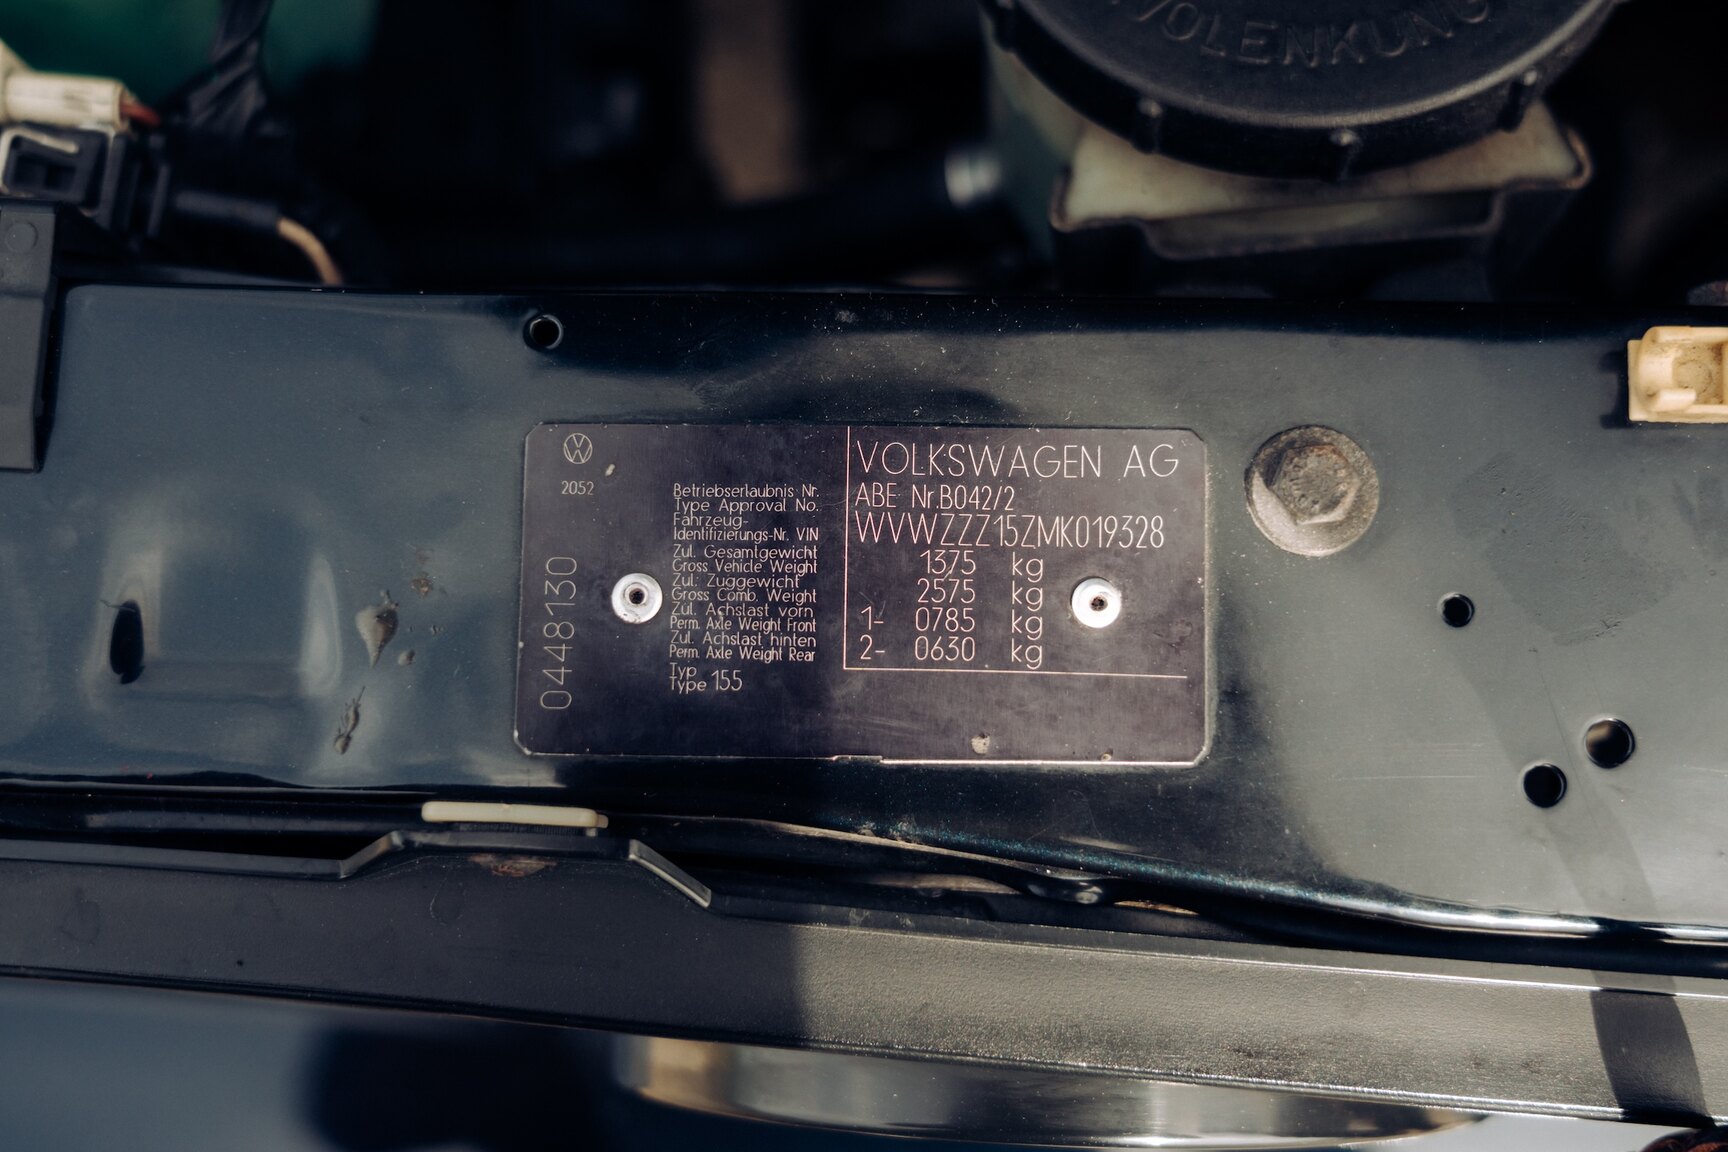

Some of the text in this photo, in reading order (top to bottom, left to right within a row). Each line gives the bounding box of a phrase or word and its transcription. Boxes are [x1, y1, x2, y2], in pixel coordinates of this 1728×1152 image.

[857, 440, 1178, 478] VOLKSWAGEN AG
[561, 480, 594, 496] 2052
[674, 483, 819, 498] Betriebserlaubnis Nr.
[855, 482, 897, 508] ABE
[675, 498, 819, 515] Type Approval No.
[674, 512, 748, 530] Fahrzeug-
[855, 511, 1164, 549] WVWZZZ15ZMK019328
[674, 527, 819, 544] Identifizierungs-Nr. VIN
[673, 544, 817, 562] Zul. Gesamtgewicht
[672, 559, 817, 577] Gross Vehicle Weight
[920, 550, 1043, 582] 1375 kg
[672, 573, 799, 590] Zul. Zuggewicht
[672, 588, 816, 606] Gross Comb. Weight
[917, 578, 1043, 611] 2575 kg
[672, 602, 813, 618] Zul. Achslast vorn
[670, 616, 816, 633] Perm. Axle Weight Front
[916, 607, 975, 632] 0785
[1011, 610, 1043, 640] kg
[540, 557, 577, 709] 0448130
[670, 630, 816, 647] Zul. Achslast hinten
[669, 645, 815, 663] Perm. Axle Weight Rear
[915, 636, 975, 661] 0630
[1011, 638, 1042, 670] kg
[670, 662, 696, 679] Typ
[670, 670, 743, 694] Type 155
